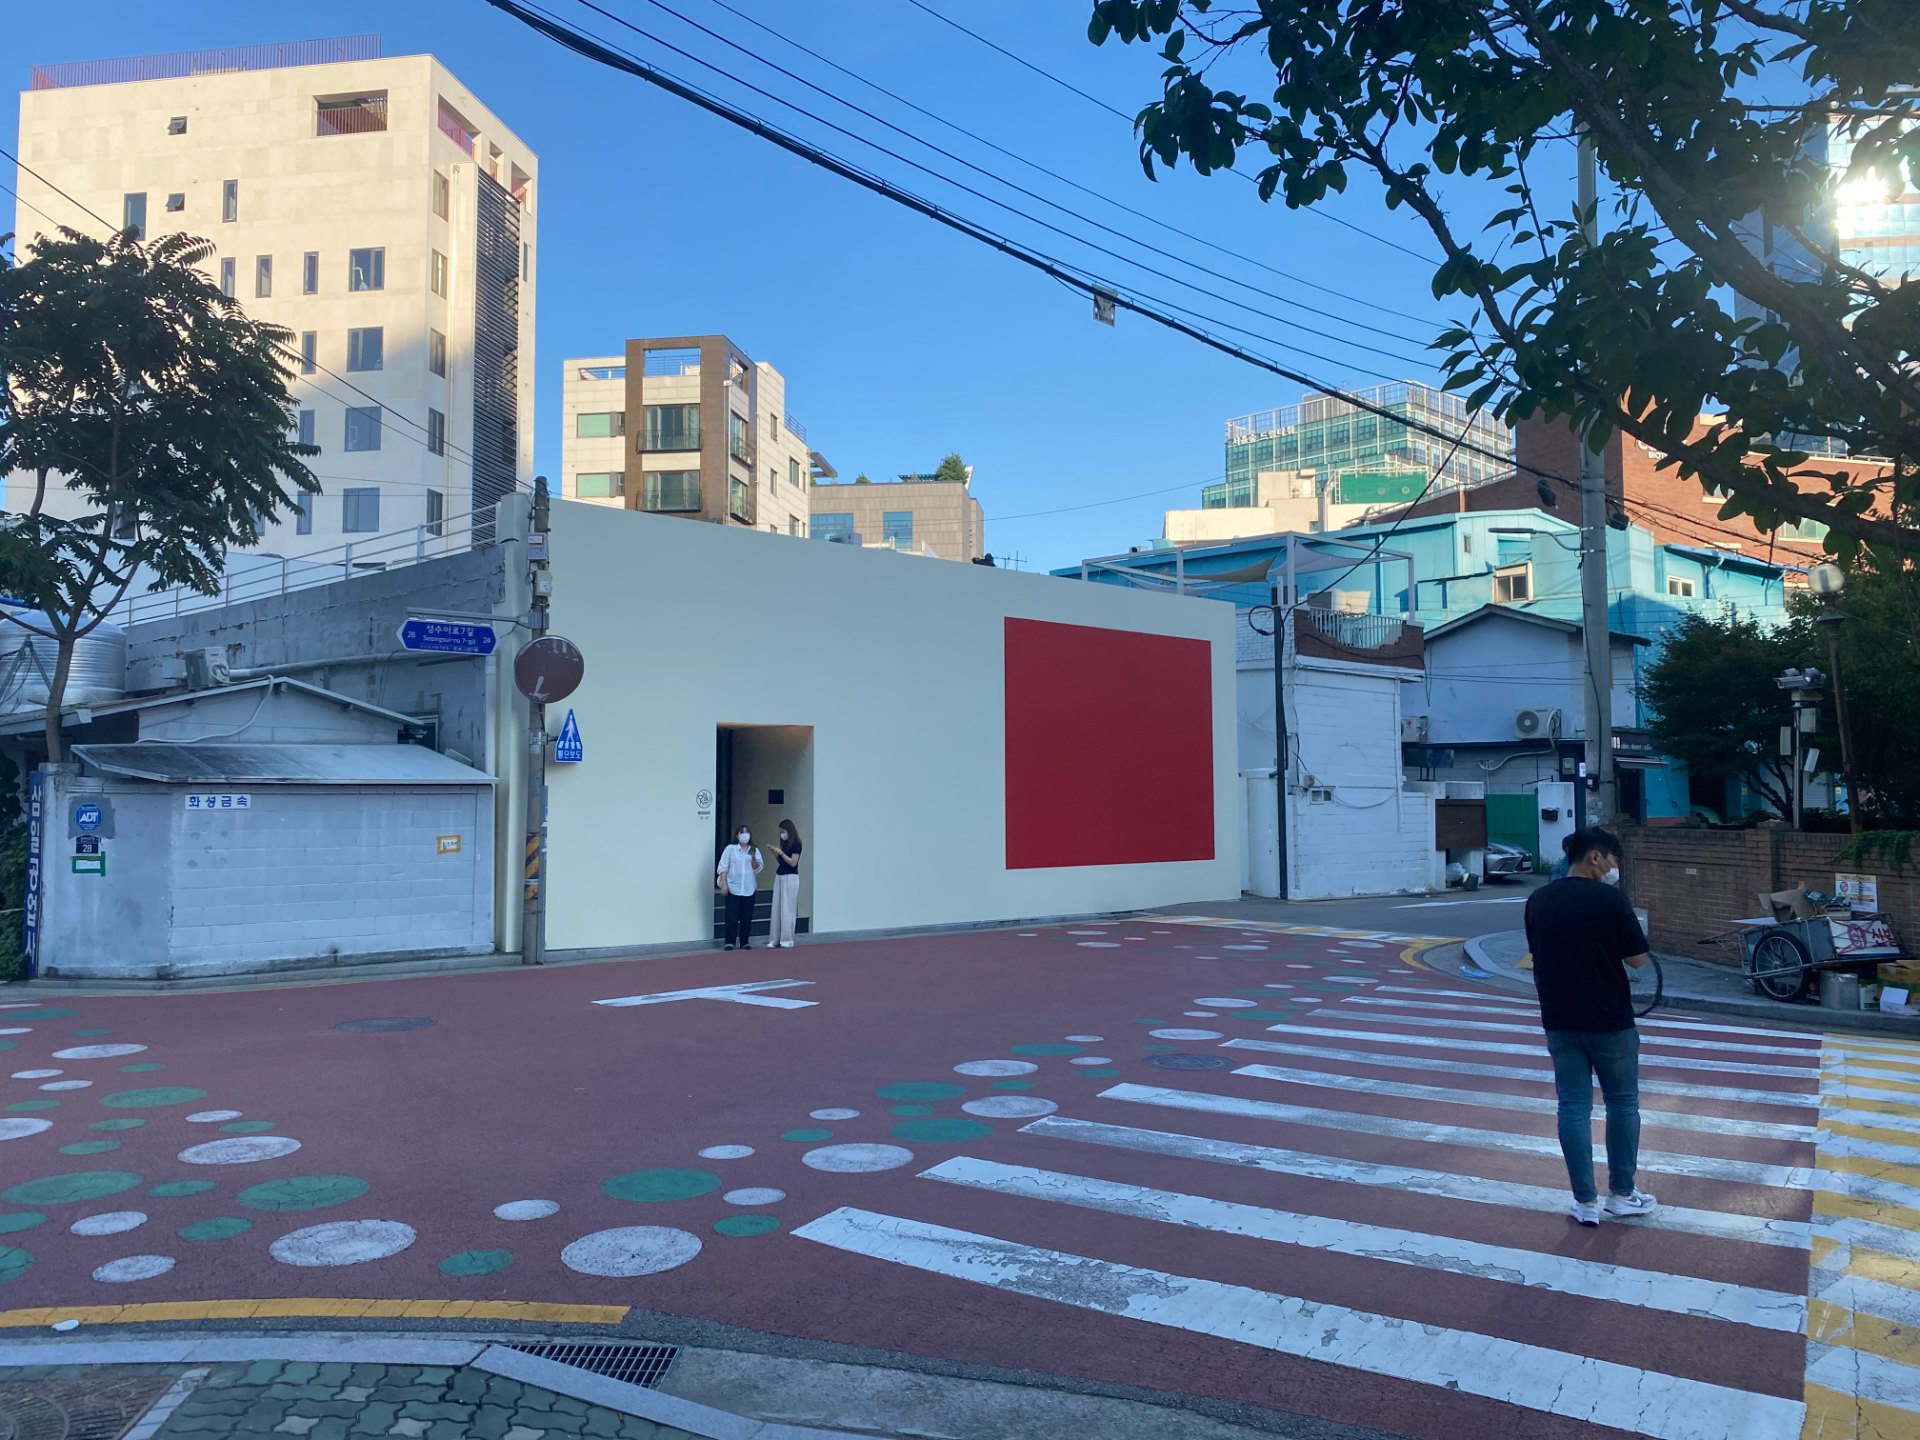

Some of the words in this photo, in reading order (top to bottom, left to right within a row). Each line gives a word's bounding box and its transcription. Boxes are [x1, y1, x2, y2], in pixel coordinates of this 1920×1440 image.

[407, 631, 416, 639] 28
[425, 624, 474, 637] 성수이로7길
[557, 750, 582, 760] 횡단보도
[188, 795, 248, 808] 화성금속
[80, 812, 99, 822] ADT
[82, 844, 93, 853] 28
[25, 785, 42, 965] 삼일공업사
